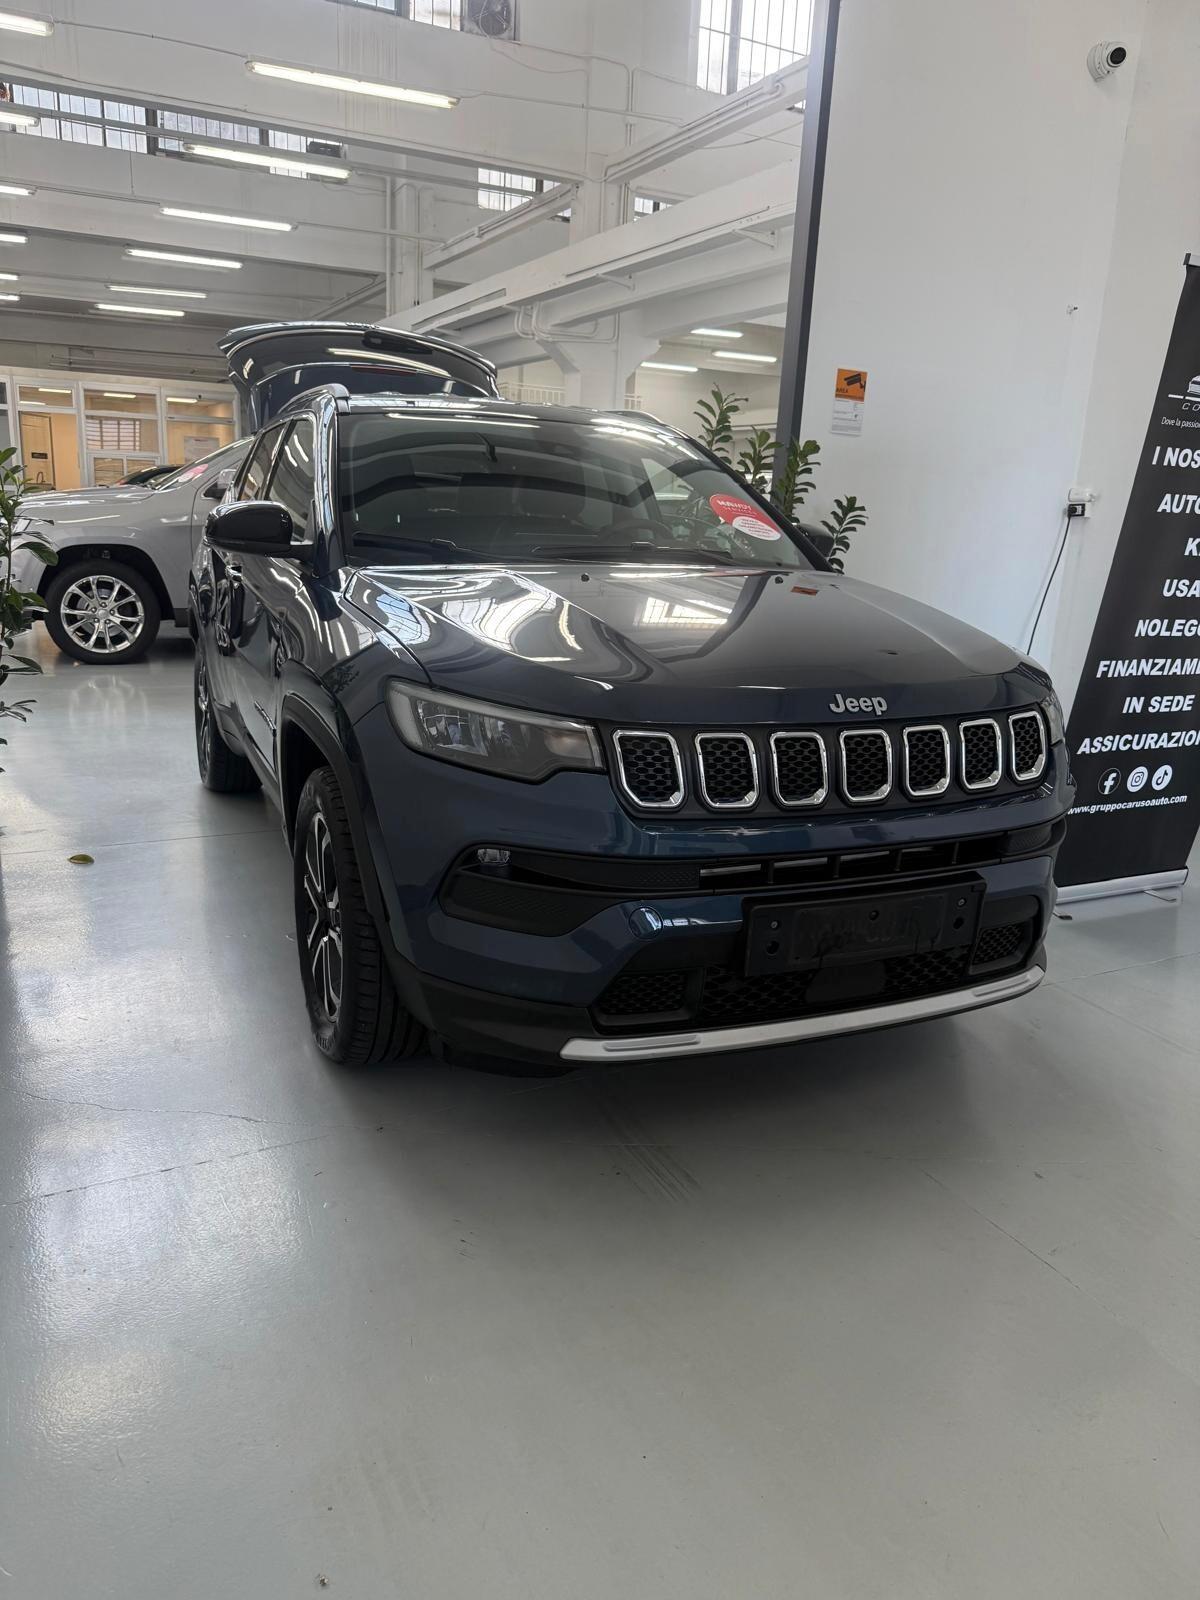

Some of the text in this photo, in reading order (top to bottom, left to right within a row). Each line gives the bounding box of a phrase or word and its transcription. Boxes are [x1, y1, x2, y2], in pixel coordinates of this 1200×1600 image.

[1161, 416, 1175, 426] Dove
[1175, 417, 1181, 427] la
[1152, 446, 1161, 465] I
[1184, 537, 1200, 556] K
[1162, 579, 1200, 598] USA
[1134, 618, 1200, 637] NOLEG
[829, 693, 888, 716] Jeep
[1122, 694, 1196, 714] IN SEDE
